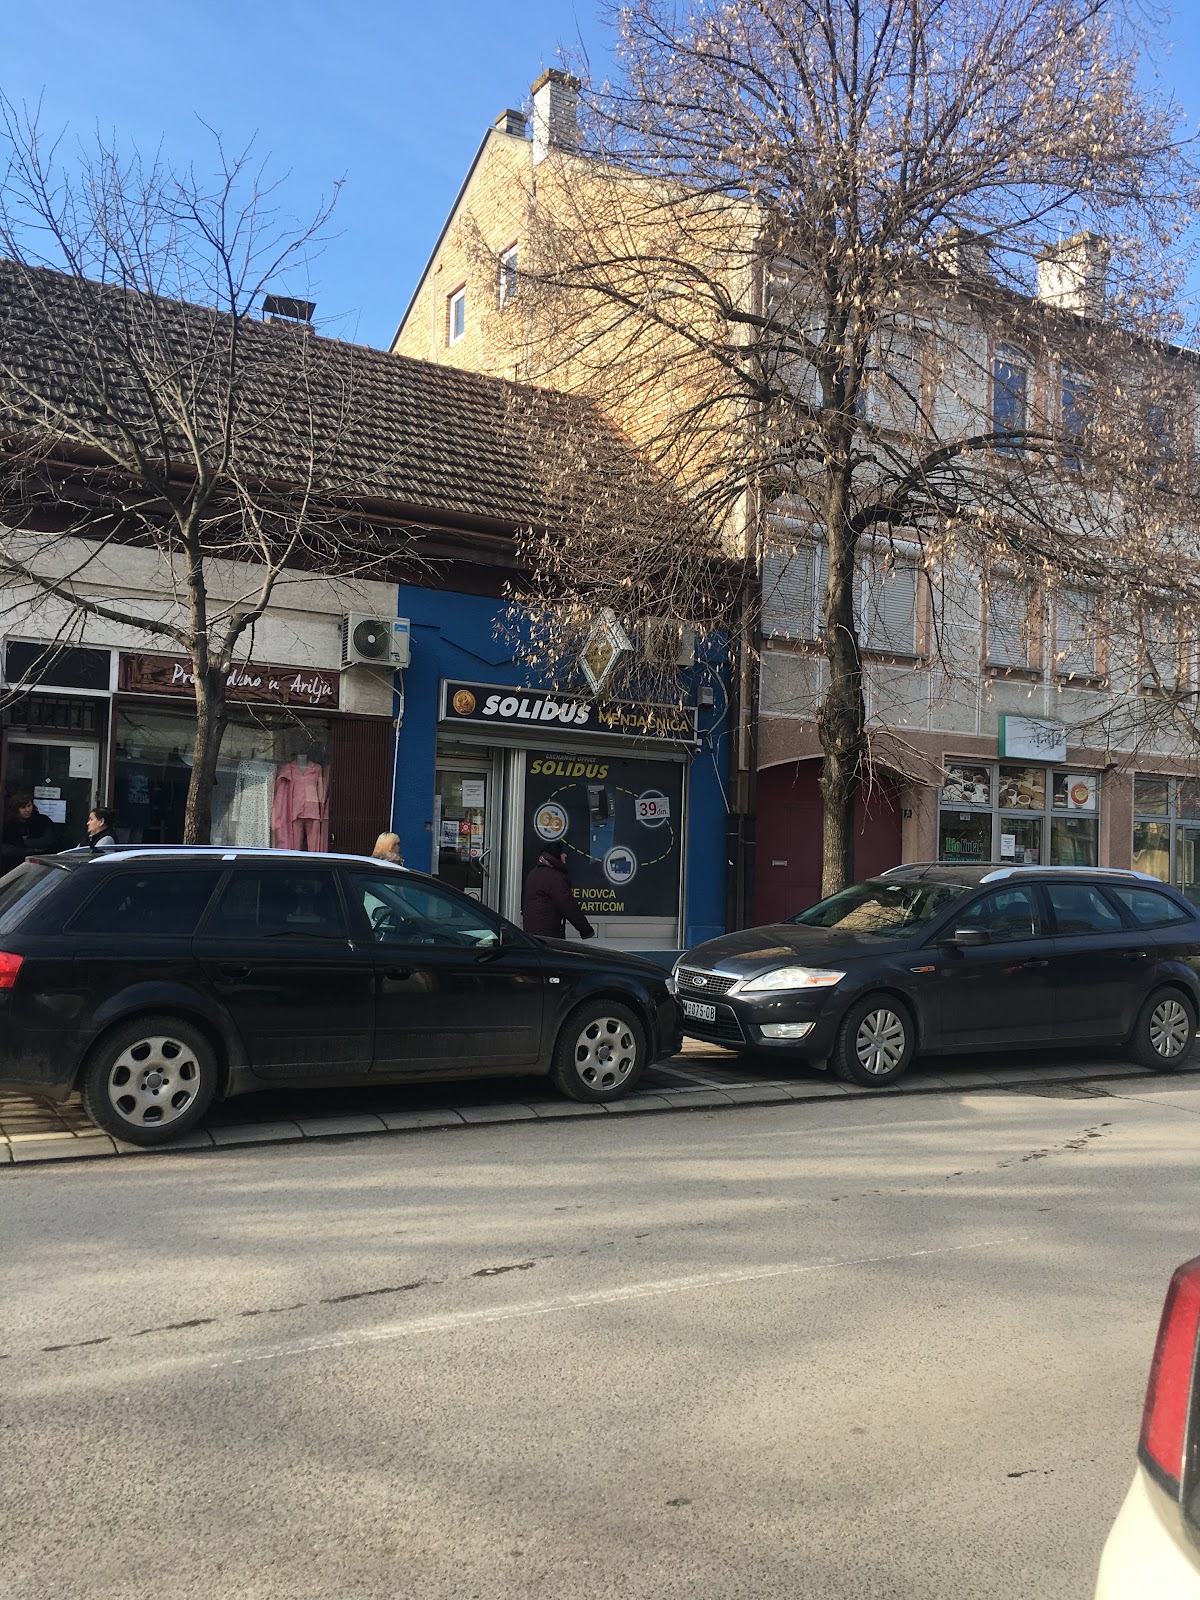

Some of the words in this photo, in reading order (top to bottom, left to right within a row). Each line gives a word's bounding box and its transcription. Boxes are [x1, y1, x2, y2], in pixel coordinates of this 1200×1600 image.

[268, 679, 280, 690] u
[290, 673, 334, 704] Arilju
[482, 695, 591, 724] SOLIDUS
[545, 753, 576, 762] EXCHANGE
[530, 759, 609, 779] SOLIDUS
[582, 888, 617, 898] NOVCA
